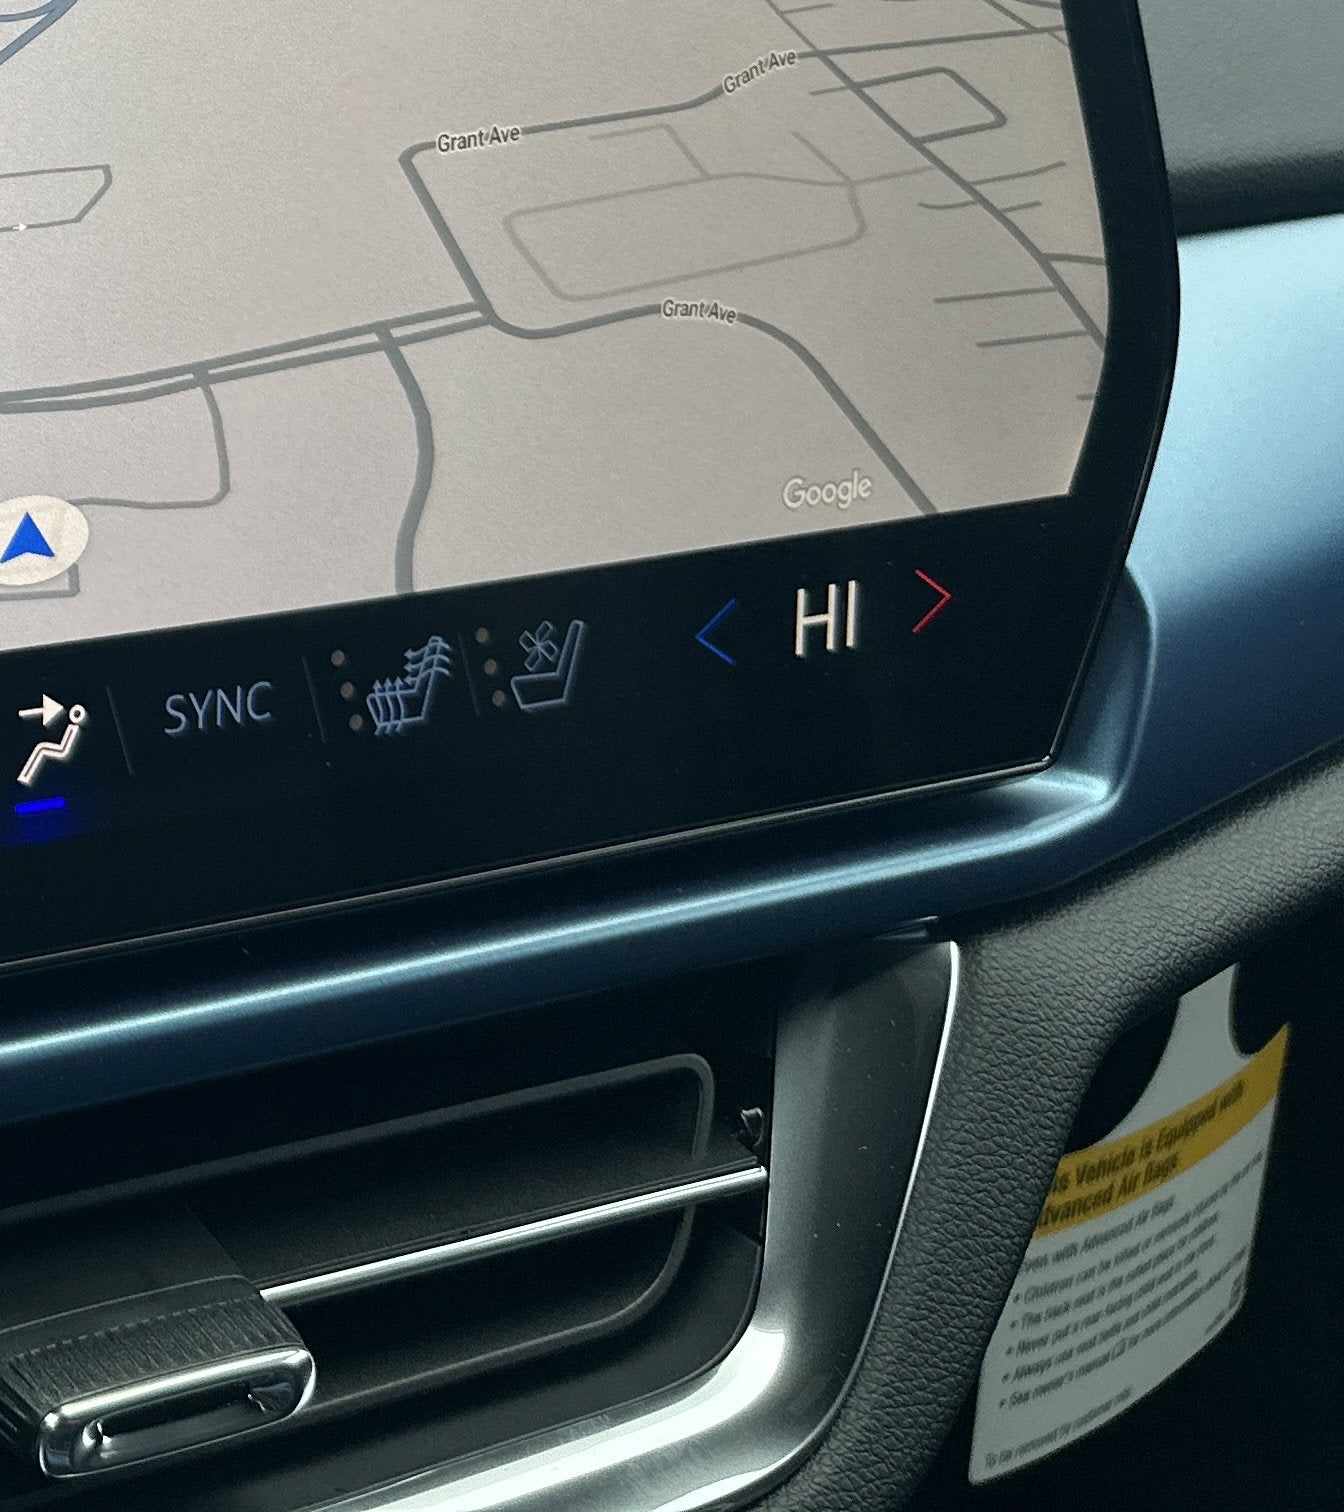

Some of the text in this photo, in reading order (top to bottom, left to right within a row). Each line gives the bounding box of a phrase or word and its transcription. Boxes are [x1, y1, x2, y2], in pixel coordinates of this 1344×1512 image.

[723, 48, 797, 94] Grant Ave
[436, 125, 521, 153] Grant Ave
[662, 299, 737, 323] Grant Ave
[782, 468, 872, 510] Google
[795, 579, 858, 658] HI
[164, 681, 272, 736] SYNC
